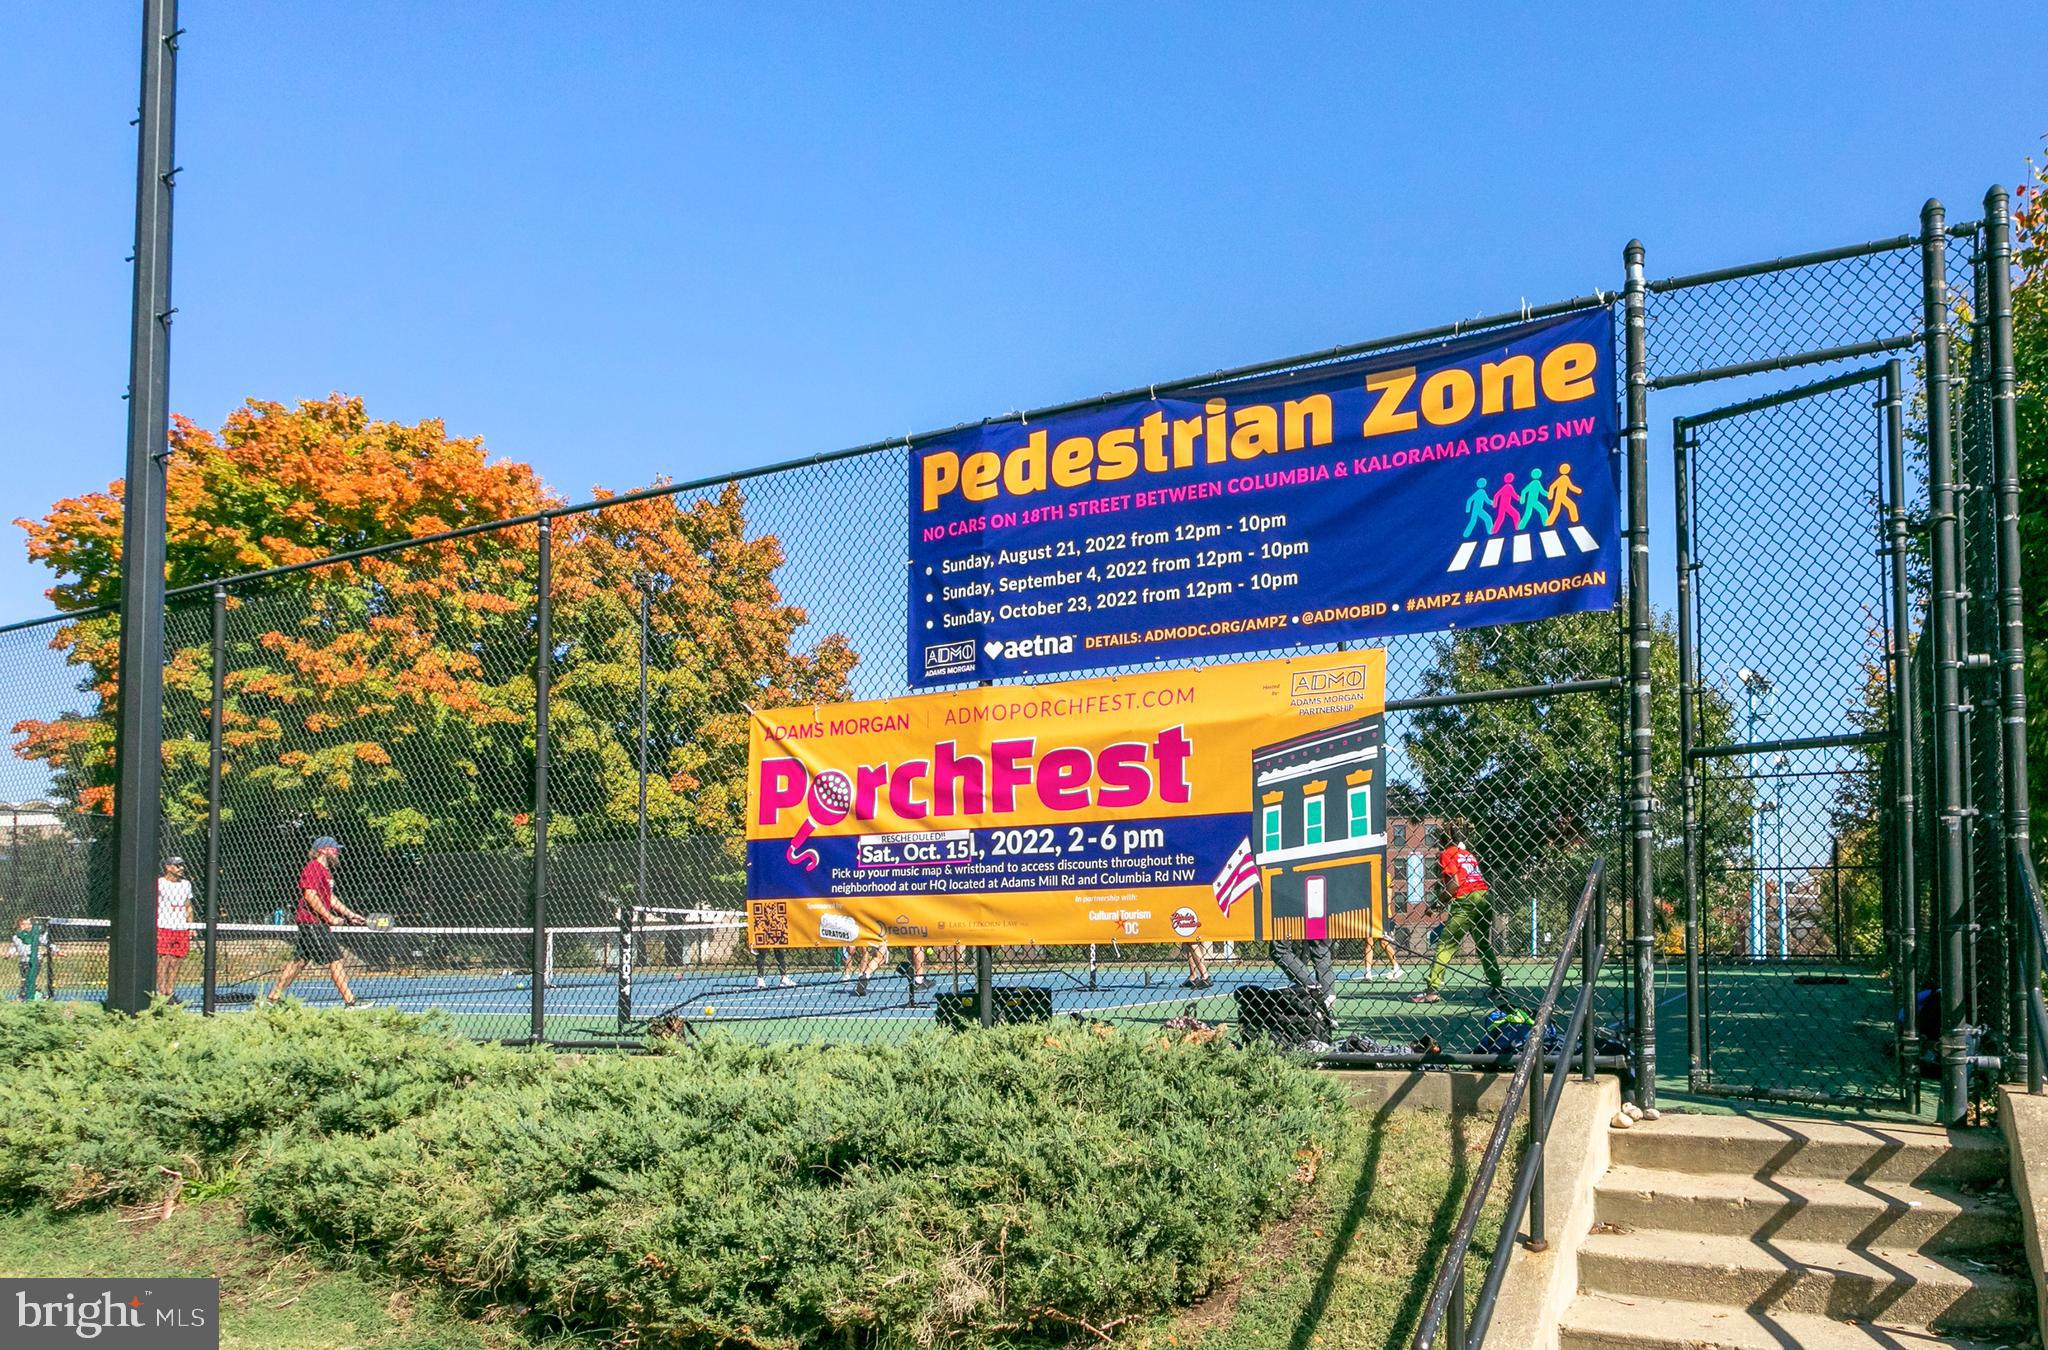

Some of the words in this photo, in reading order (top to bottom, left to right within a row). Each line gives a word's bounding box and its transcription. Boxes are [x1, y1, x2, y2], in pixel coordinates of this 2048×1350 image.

[922, 393, 1333, 512] Pedestrian
[1362, 342, 1598, 438] Zone
[923, 526, 945, 542] NO
[948, 517, 986, 536] CARS
[990, 513, 1017, 529] ON
[1022, 505, 1063, 525] 18TH
[1068, 494, 1131, 517] STREET
[1135, 481, 1222, 508] BETWEEN
[1227, 466, 1329, 494] COLUMBIA
[1334, 462, 1348, 478] &
[1354, 441, 1470, 474] KALORAMA
[1476, 425, 1549, 452] ROADS
[1555, 417, 1596, 440] NW
[942, 554, 995, 574] Sunday,
[998, 545, 1052, 565] August
[1056, 541, 1081, 557] 21,
[1085, 534, 1126, 553] 2022
[1131, 531, 1169, 547] from
[1174, 523, 1221, 541] 12pm
[1239, 514, 1287, 532] 10pm
[943, 582, 995, 601] Sunday,
[999, 570, 1083, 596] September
[1086, 567, 1101, 582] 4,
[1106, 560, 1147, 579] 2022
[1152, 557, 1191, 573] from
[1196, 549, 1242, 567] 12pm
[1261, 541, 1309, 559] 10pm
[943, 609, 995, 628] Sunday,
[999, 602, 1063, 620] October
[1067, 596, 1092, 613] 23,
[1097, 590, 1137, 609] 2022
[1142, 587, 1181, 603] from
[1186, 580, 1232, 599] 12pm
[1250, 572, 1298, 590] 10pm
[1085, 632, 1142, 649] DETAILS:
[1145, 615, 1287, 643] ADMODC.ORG/AMPZ
[1302, 602, 1387, 625] @ADMOBID
[1406, 592, 1461, 611] #AMPZ
[1464, 571, 1607, 604] #ADAMSMORGAN
[927, 645, 974, 665] ADMO
[1004, 635, 1073, 659] aetna
[925, 667, 946, 677] ADAMS
[947, 664, 975, 675] MORGAN
[1294, 670, 1362, 692] ADMO
[944, 687, 1195, 726] ADMOPORCHFEST.COM
[1290, 697, 1322, 707] ADAMS
[1324, 693, 1364, 704] MORGAN
[1299, 703, 1354, 716] PARTNERSHIP
[764, 722, 824, 742] ADAMS
[829, 714, 910, 736] MORGAN
[759, 723, 1193, 827] PorchFest
[862, 845, 900, 865] Sat.,
[903, 843, 941, 861] Oct.
[991, 827, 1062, 857] 2022,
[1123, 827, 1164, 854] pm
[881, 832, 946, 843] RESCHEDULED!!
[832, 868, 851, 879] Pick
[853, 868, 865, 879] up
[867, 867, 889, 878] your
[892, 866, 919, 877] music
[922, 866, 942, 877] map
[945, 864, 953, 875] &
[954, 863, 1004, 875] wristband
[1007, 863, 1018, 872] to
[1021, 861, 1055, 872] access
[1057, 857, 1108, 870] discounts
[1111, 855, 1172, 869] throughout
[1176, 853, 1194, 865] the
[831, 880, 897, 894] neighborhood
[900, 882, 909, 891] at
[911, 883, 928, 891] our
[930, 880, 947, 891] HQ
[949, 878, 985, 889] located
[988, 879, 998, 888] at
[1001, 876, 1036, 888] Adams
[1038, 875, 1058, 886] Mill
[1061, 874, 1075, 885] Rd
[1078, 873, 1097, 884] and
[1100, 871, 1151, 884] Columbia
[1155, 870, 1169, 882] Rd
[1172, 869, 1195, 881] NW
[1075, 895, 1082, 903] In
[1083, 894, 1120, 904] partnership
[1121, 894, 1138, 902] with:
[1089, 909, 1119, 921] Cultural
[1120, 908, 1152, 920] Tourism
[821, 928, 850, 940] CURATORS
[1125, 922, 1139, 935] DC
